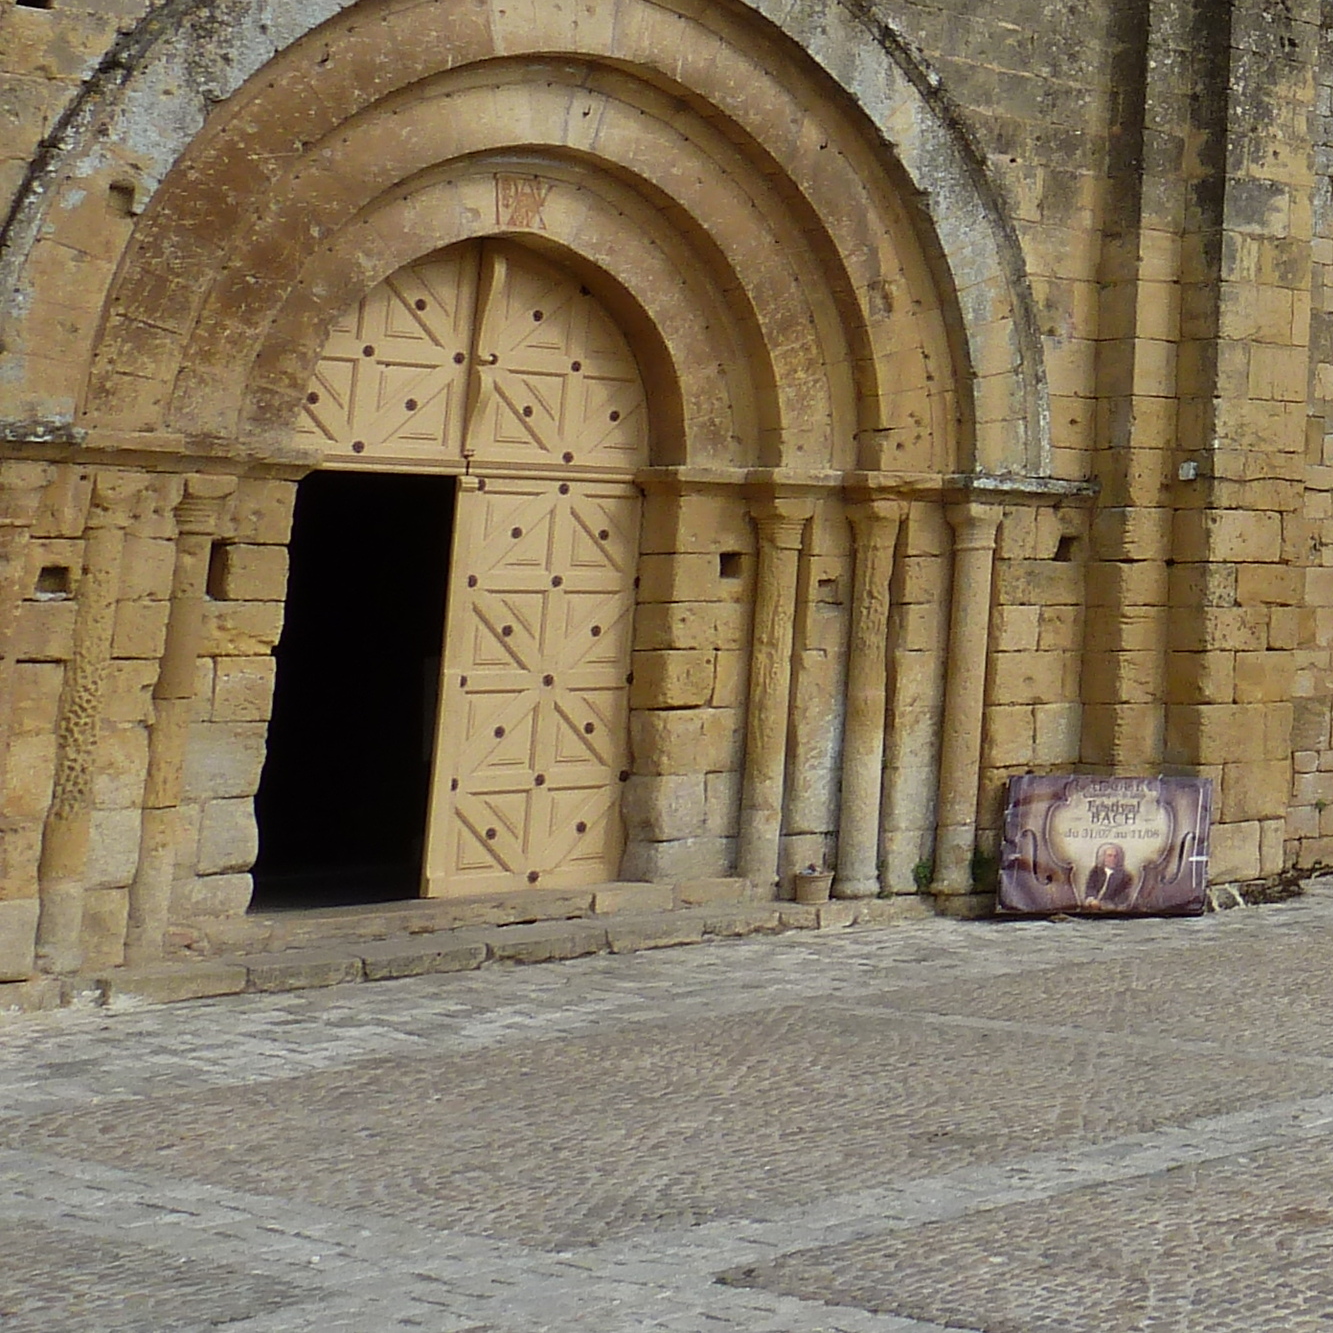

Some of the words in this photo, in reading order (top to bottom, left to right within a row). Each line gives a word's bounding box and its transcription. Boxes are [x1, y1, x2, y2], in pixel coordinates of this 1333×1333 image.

[1087, 799, 1141, 815] Festival
[1091, 812, 1136, 825] BACH
[1064, 827, 1079, 839] du
[1113, 829, 1128, 839] au
